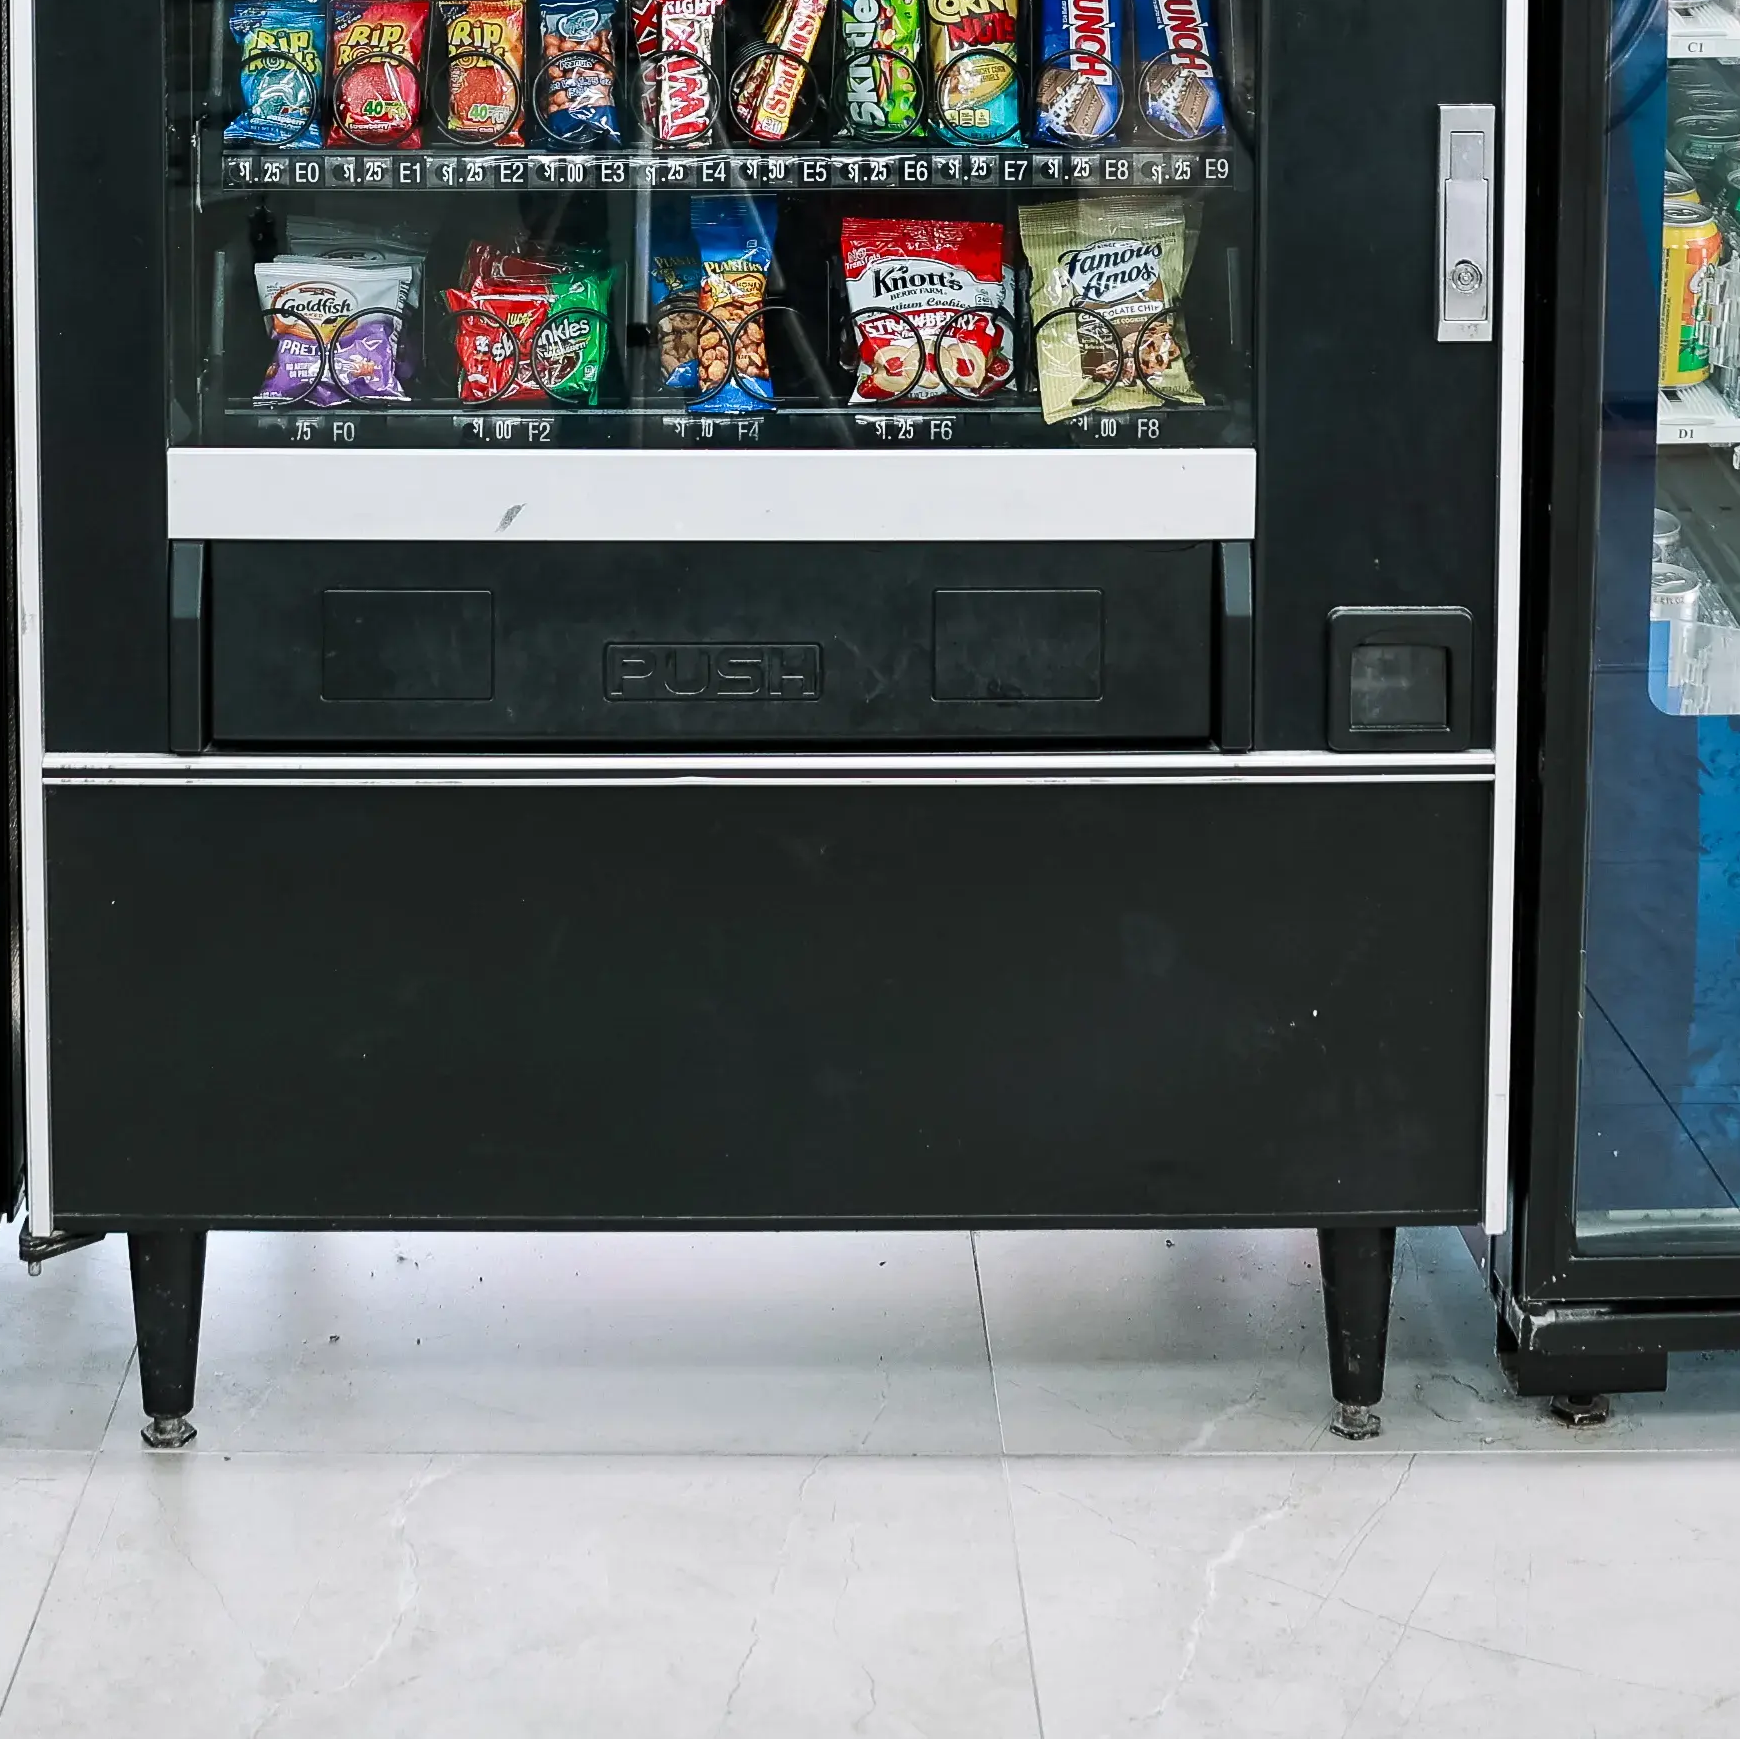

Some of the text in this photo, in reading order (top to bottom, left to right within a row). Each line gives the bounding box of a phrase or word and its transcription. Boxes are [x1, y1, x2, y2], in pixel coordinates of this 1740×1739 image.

[803, 163, 827, 183] E5
[1063, 241, 1162, 280] Famous
[872, 266, 963, 300] Knott's
[890, 288, 943, 302] BERRY FARM
[1081, 265, 1153, 303] Amos
[280, 297, 353, 320] Goldfish
[930, 420, 953, 440] F6
[610, 658, 817, 697] PUSH
